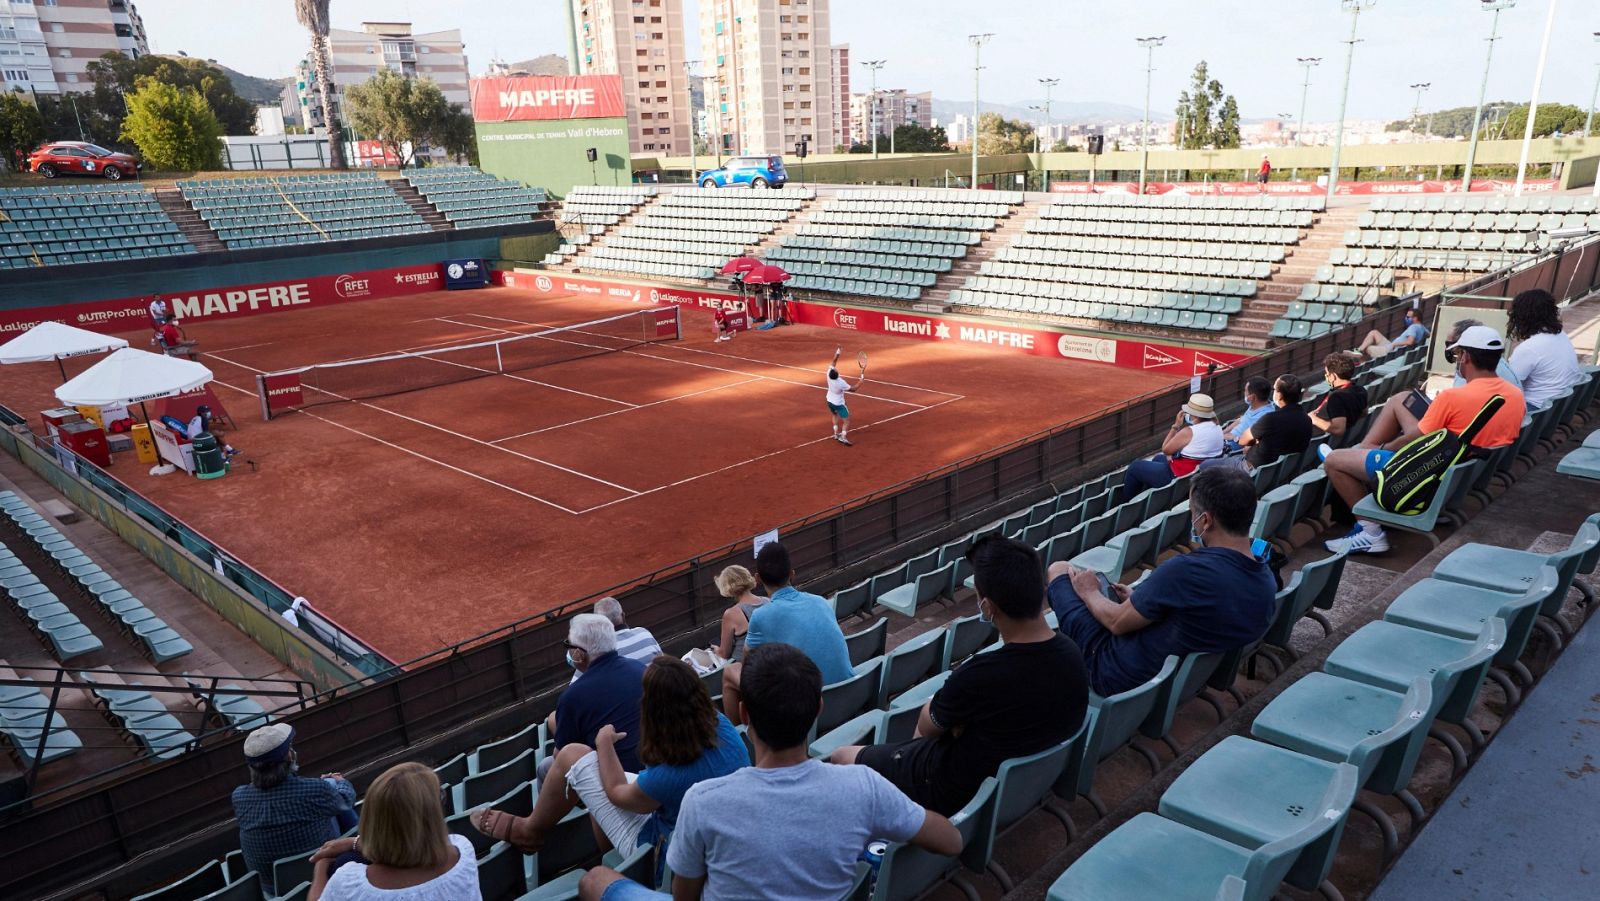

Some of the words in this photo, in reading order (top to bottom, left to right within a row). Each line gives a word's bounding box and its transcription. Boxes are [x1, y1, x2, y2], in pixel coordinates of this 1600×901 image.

[499, 88, 595, 108] MAPFRE
[481, 134, 504, 142] CENTRE
[505, 133, 536, 141] MUNICIPAL
[536, 132, 545, 140] DE
[545, 131, 566, 139] TENNIS
[567, 127, 584, 138] Vall
[585, 126, 624, 137] d'Hebron
[1379, 184, 1424, 193] MAPFRE
[405, 272, 439, 282] ESTRELLA
[345, 279, 369, 291] RFET
[537, 277, 551, 290] KIA
[172, 283, 310, 319] MAPFRE
[660, 293, 693, 304] LaLigaSports
[698, 297, 746, 312] HEAD
[840, 315, 857, 324] RFET
[884, 315, 931, 336] luanvi
[960, 326, 1034, 349] MAPFRE
[1064, 345, 1093, 353] Barcelona
[269, 386, 301, 396] MAPFRE
